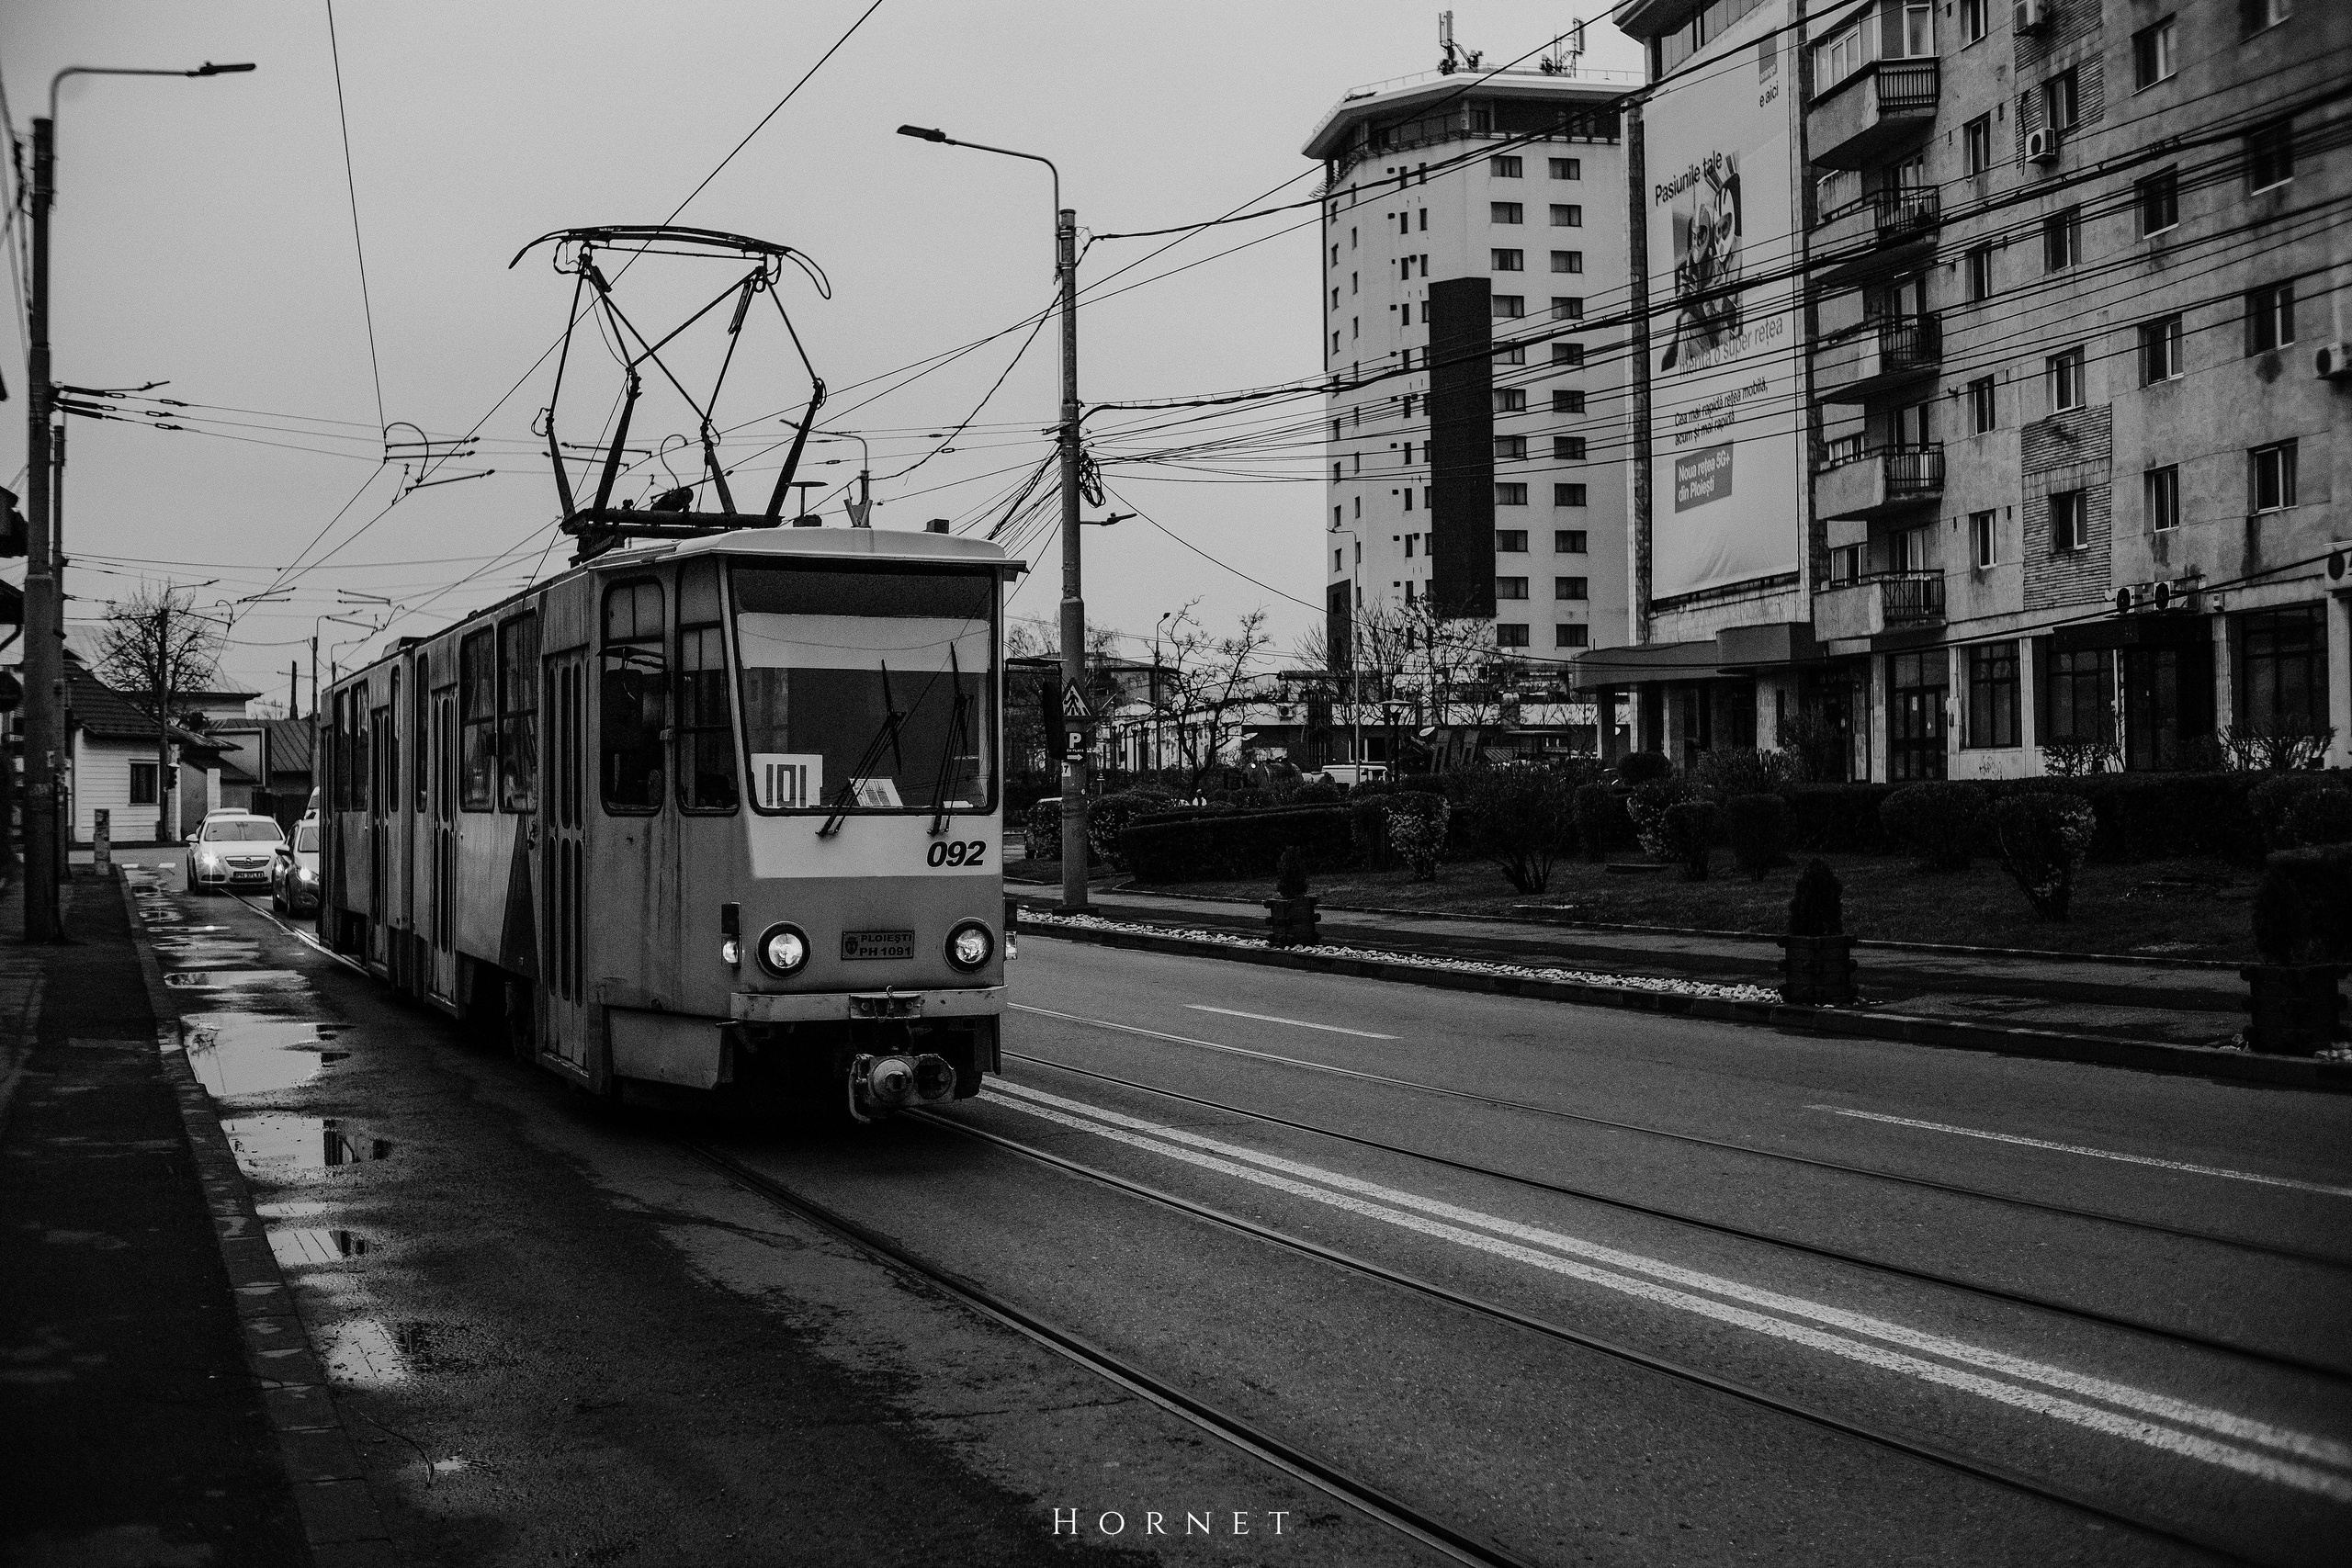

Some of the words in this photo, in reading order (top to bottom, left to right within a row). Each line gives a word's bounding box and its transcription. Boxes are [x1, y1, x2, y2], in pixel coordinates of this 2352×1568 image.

[1759, 95, 1765, 107] e
[1765, 80, 1779, 104] aici
[1655, 163, 1701, 207] Pasiunile
[1702, 150, 1723, 178] tale
[1714, 347, 1721, 365] o
[1723, 332, 1752, 361] super
[1675, 412, 1688, 426] Cea
[1679, 464, 1697, 482] Noua
[1716, 449, 1731, 469] 5G+
[1679, 485, 1690, 502] din
[1069, 732, 1082, 749] P
[926, 840, 987, 867] 092
[859, 947, 878, 956] PH
[880, 946, 910, 956] 1091
